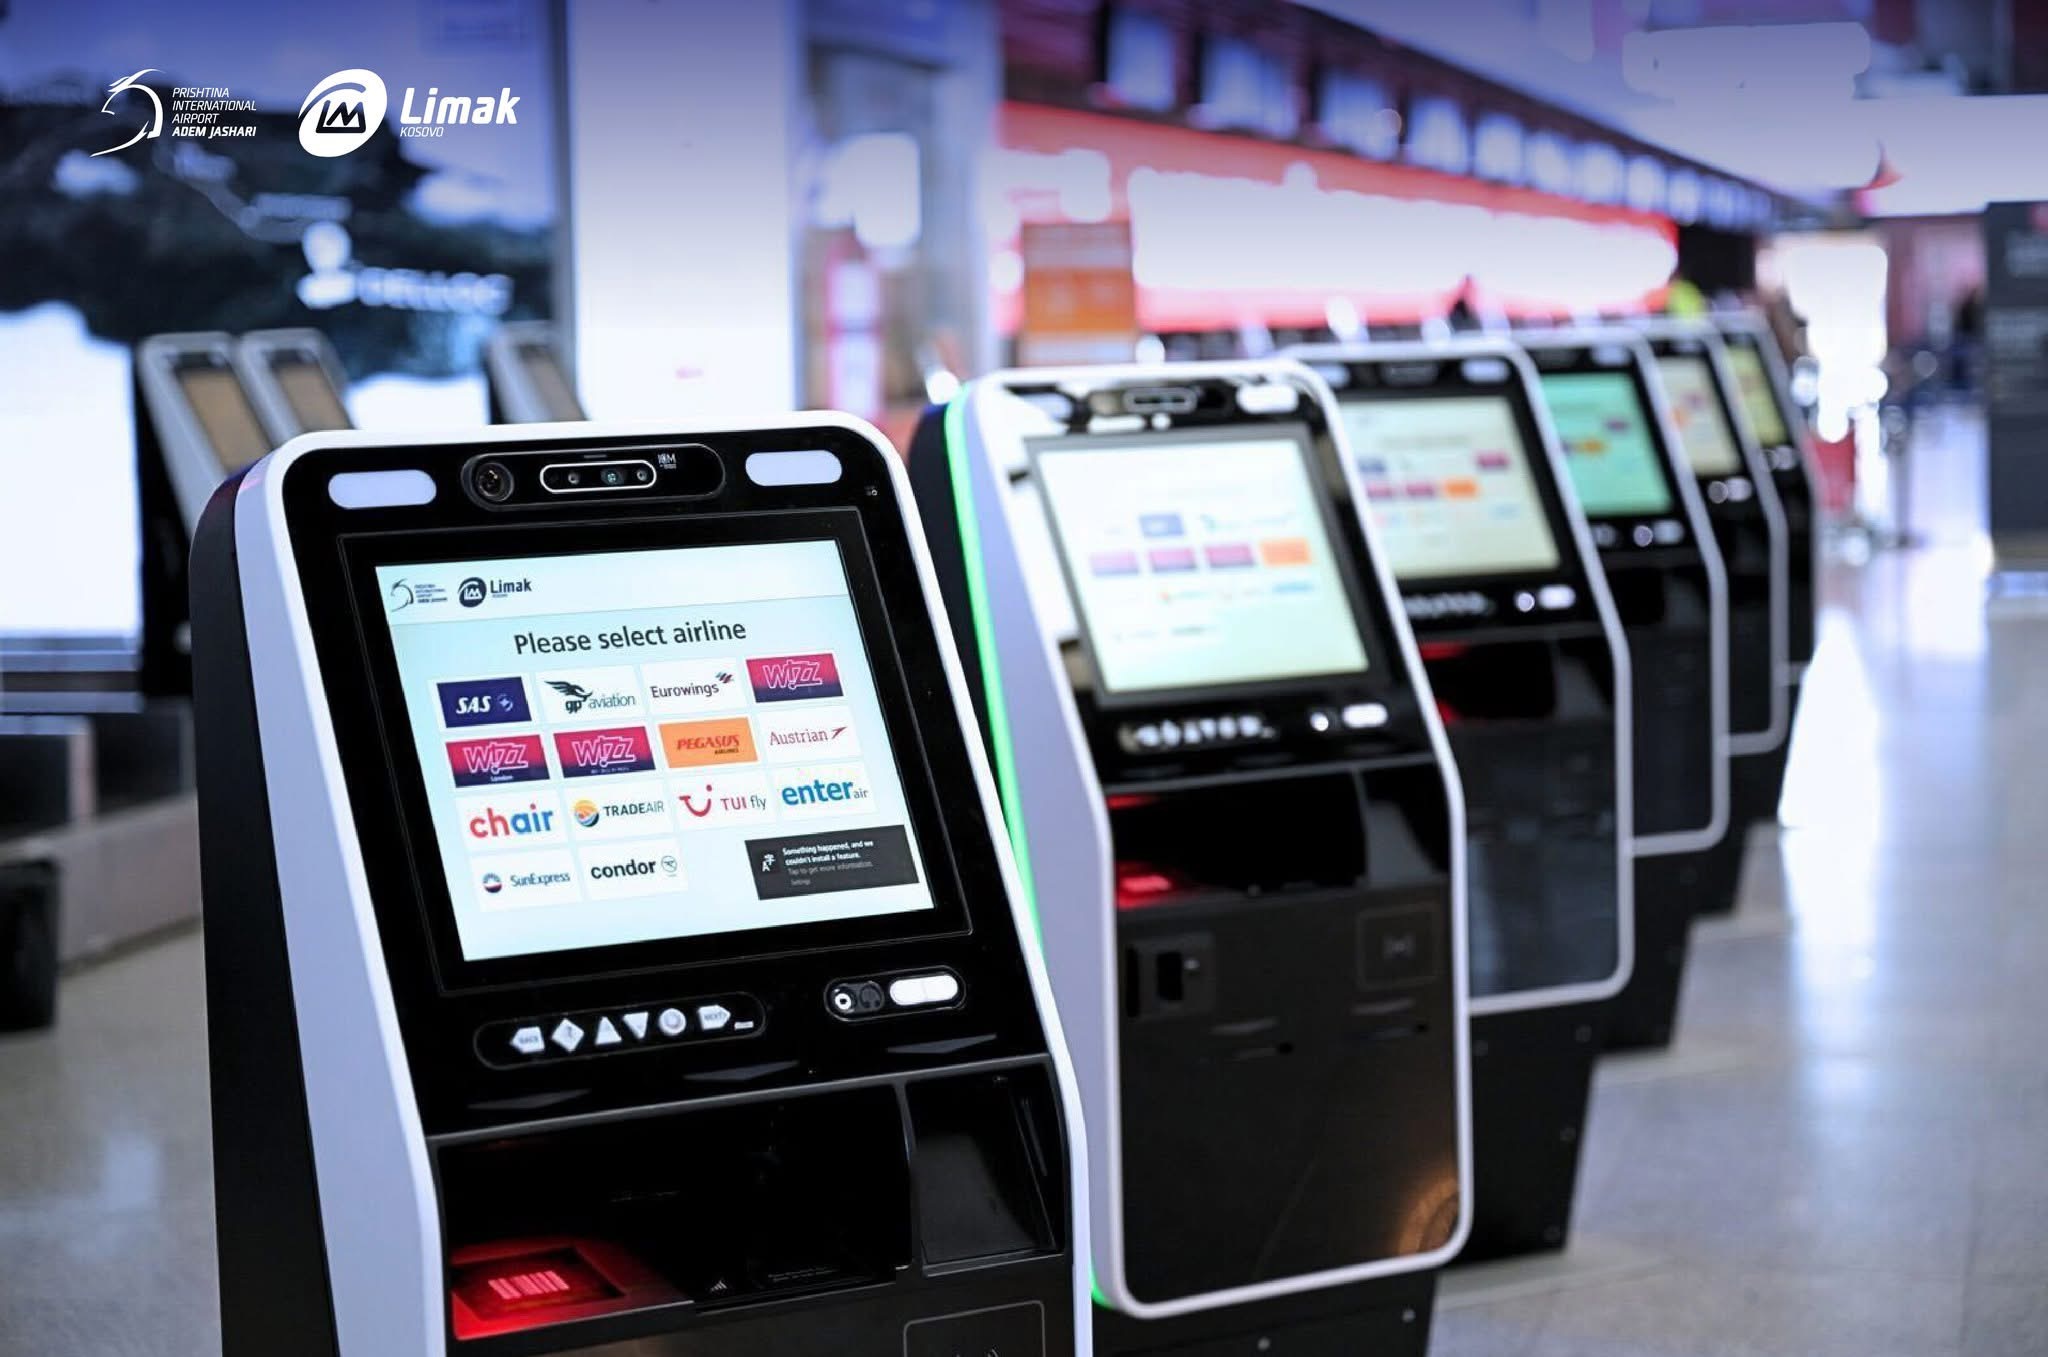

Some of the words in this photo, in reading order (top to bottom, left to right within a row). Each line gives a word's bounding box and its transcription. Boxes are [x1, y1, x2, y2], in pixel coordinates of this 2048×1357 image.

[490, 578, 533, 594] Limak
[513, 631, 592, 655] Please
[598, 625, 668, 650] select
[673, 619, 747, 644] airline
[650, 682, 720, 699] Eurowings
[455, 694, 492, 715] SAS
[588, 693, 637, 710] aviation
[677, 733, 740, 751] PEGASUS
[769, 727, 828, 746] Austrian
[781, 778, 854, 806] enter
[853, 788, 869, 800] air
[602, 800, 665, 817] TRADEAIR
[720, 796, 748, 811] TUI
[750, 794, 767, 811] fly
[469, 803, 554, 838] chair
[782, 846, 817, 856] Something
[851, 840, 864, 848] and
[811, 854, 830, 863] install
[590, 858, 657, 880] condor
[509, 872, 571, 888] SunExpress
